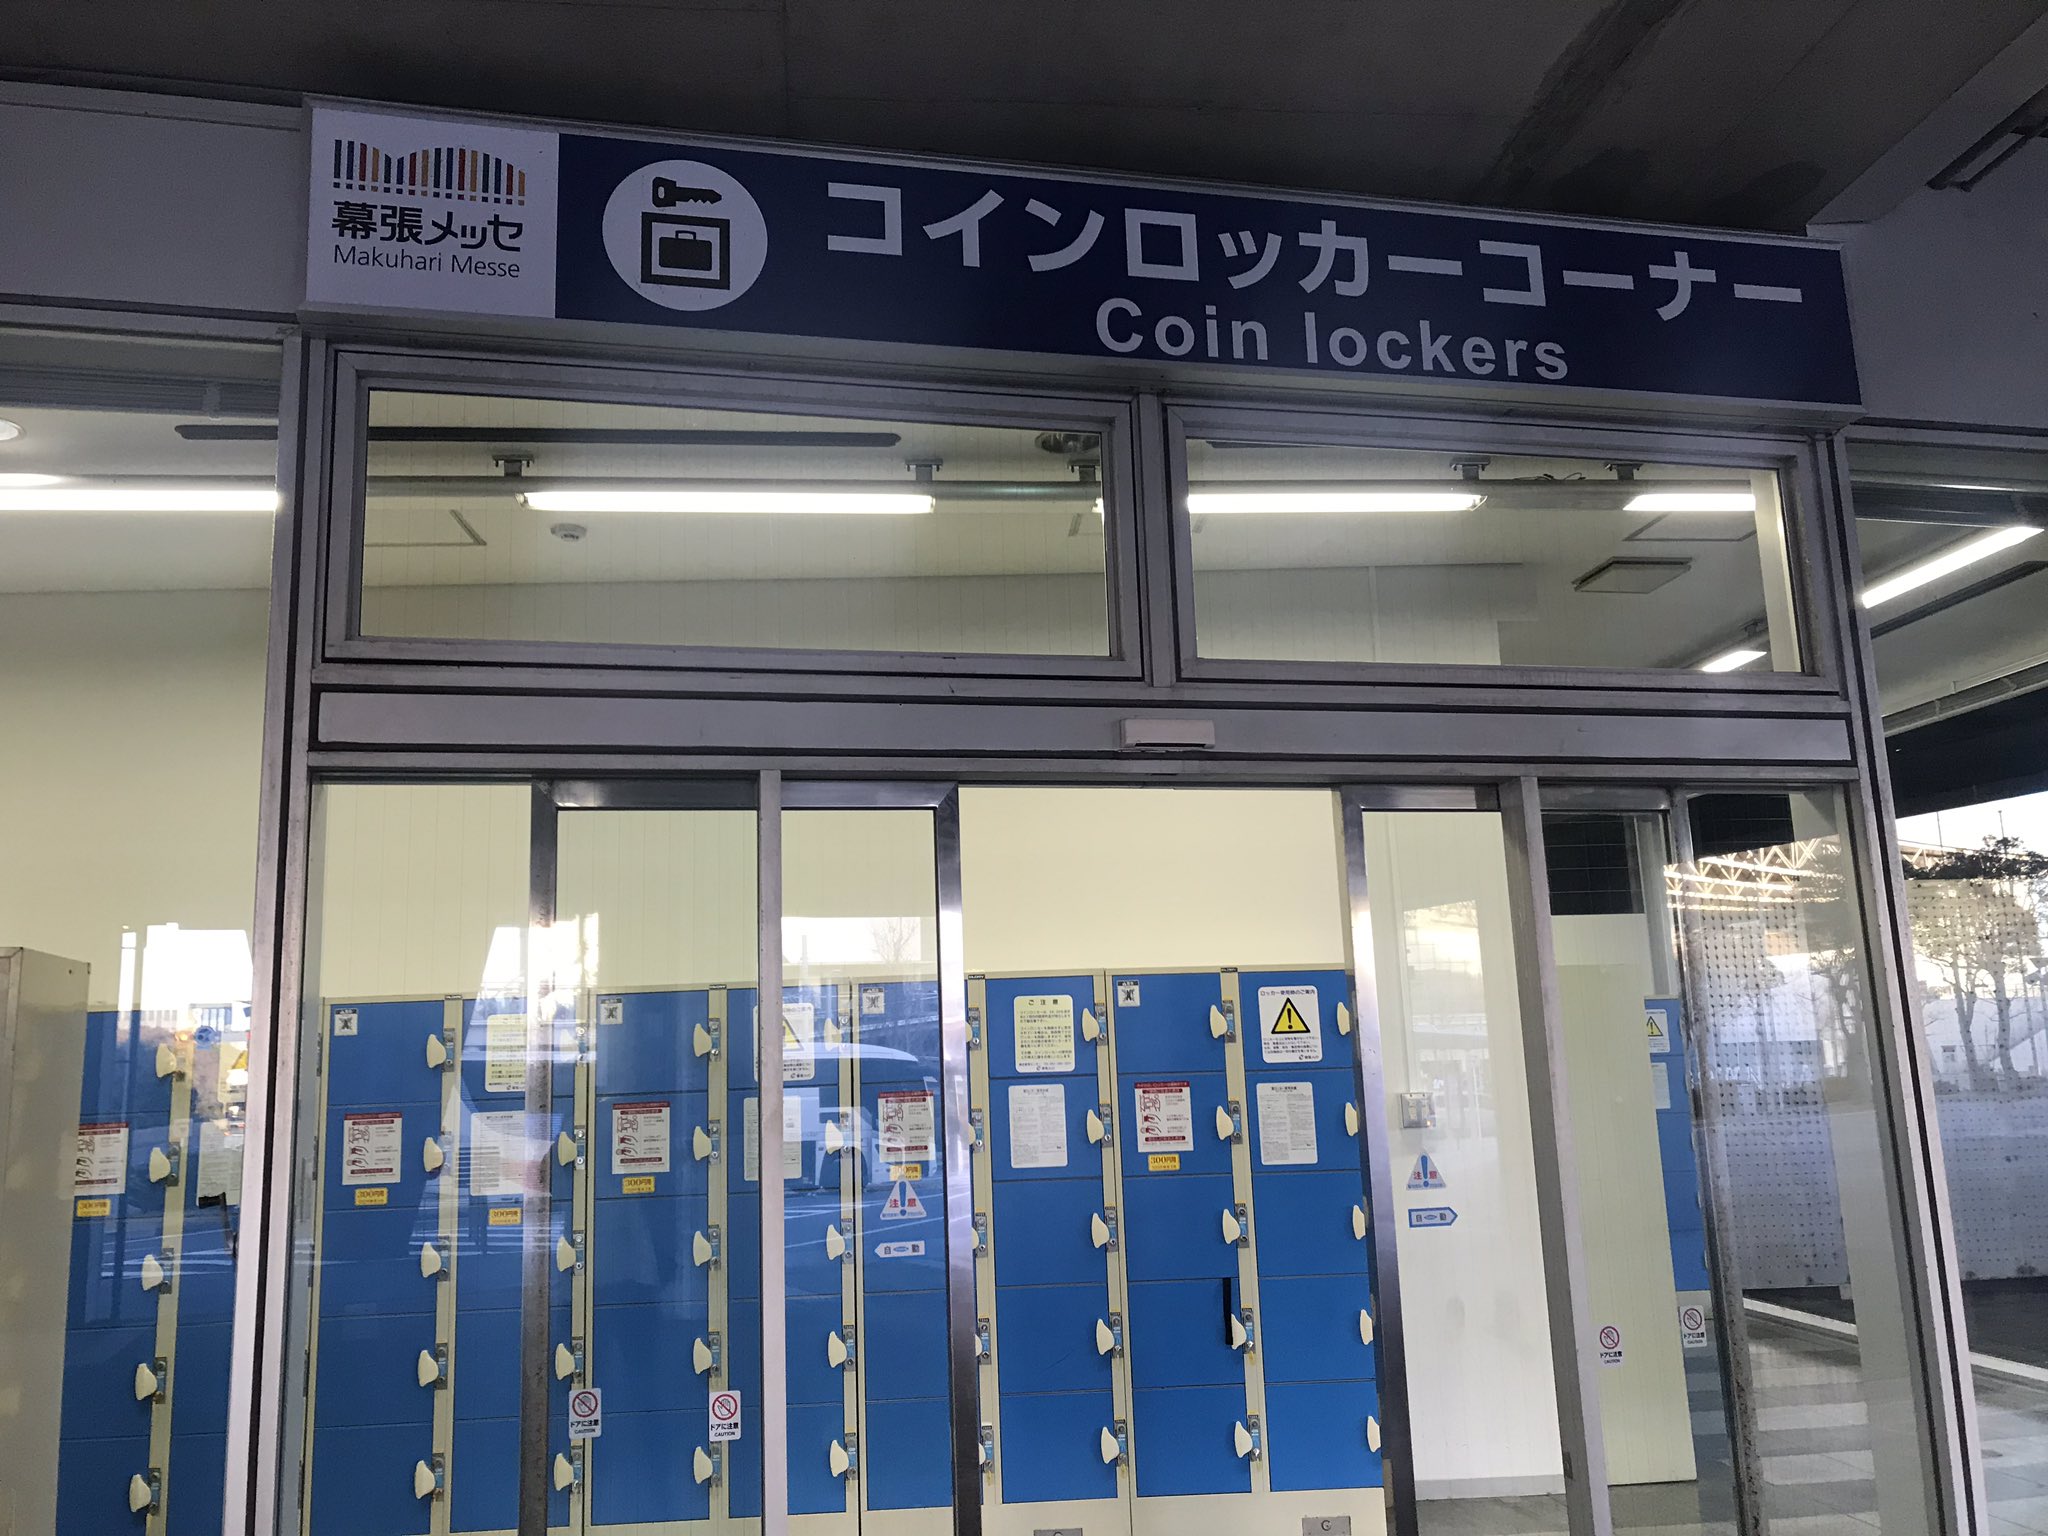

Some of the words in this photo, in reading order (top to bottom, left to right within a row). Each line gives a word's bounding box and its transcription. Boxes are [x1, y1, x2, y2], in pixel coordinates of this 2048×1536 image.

[332, 200, 523, 253] 幕張メッセ
[334, 244, 443, 273] Makuhari
[451, 255, 521, 279] Messe
[826, 182, 1804, 322] コインロッカーコーナー
[1096, 297, 1268, 362] Coin
[1305, 311, 1569, 381] lockers
[570, 1419, 599, 1428] ドアに注意
[710, 1422, 739, 1431] ドアに注意
